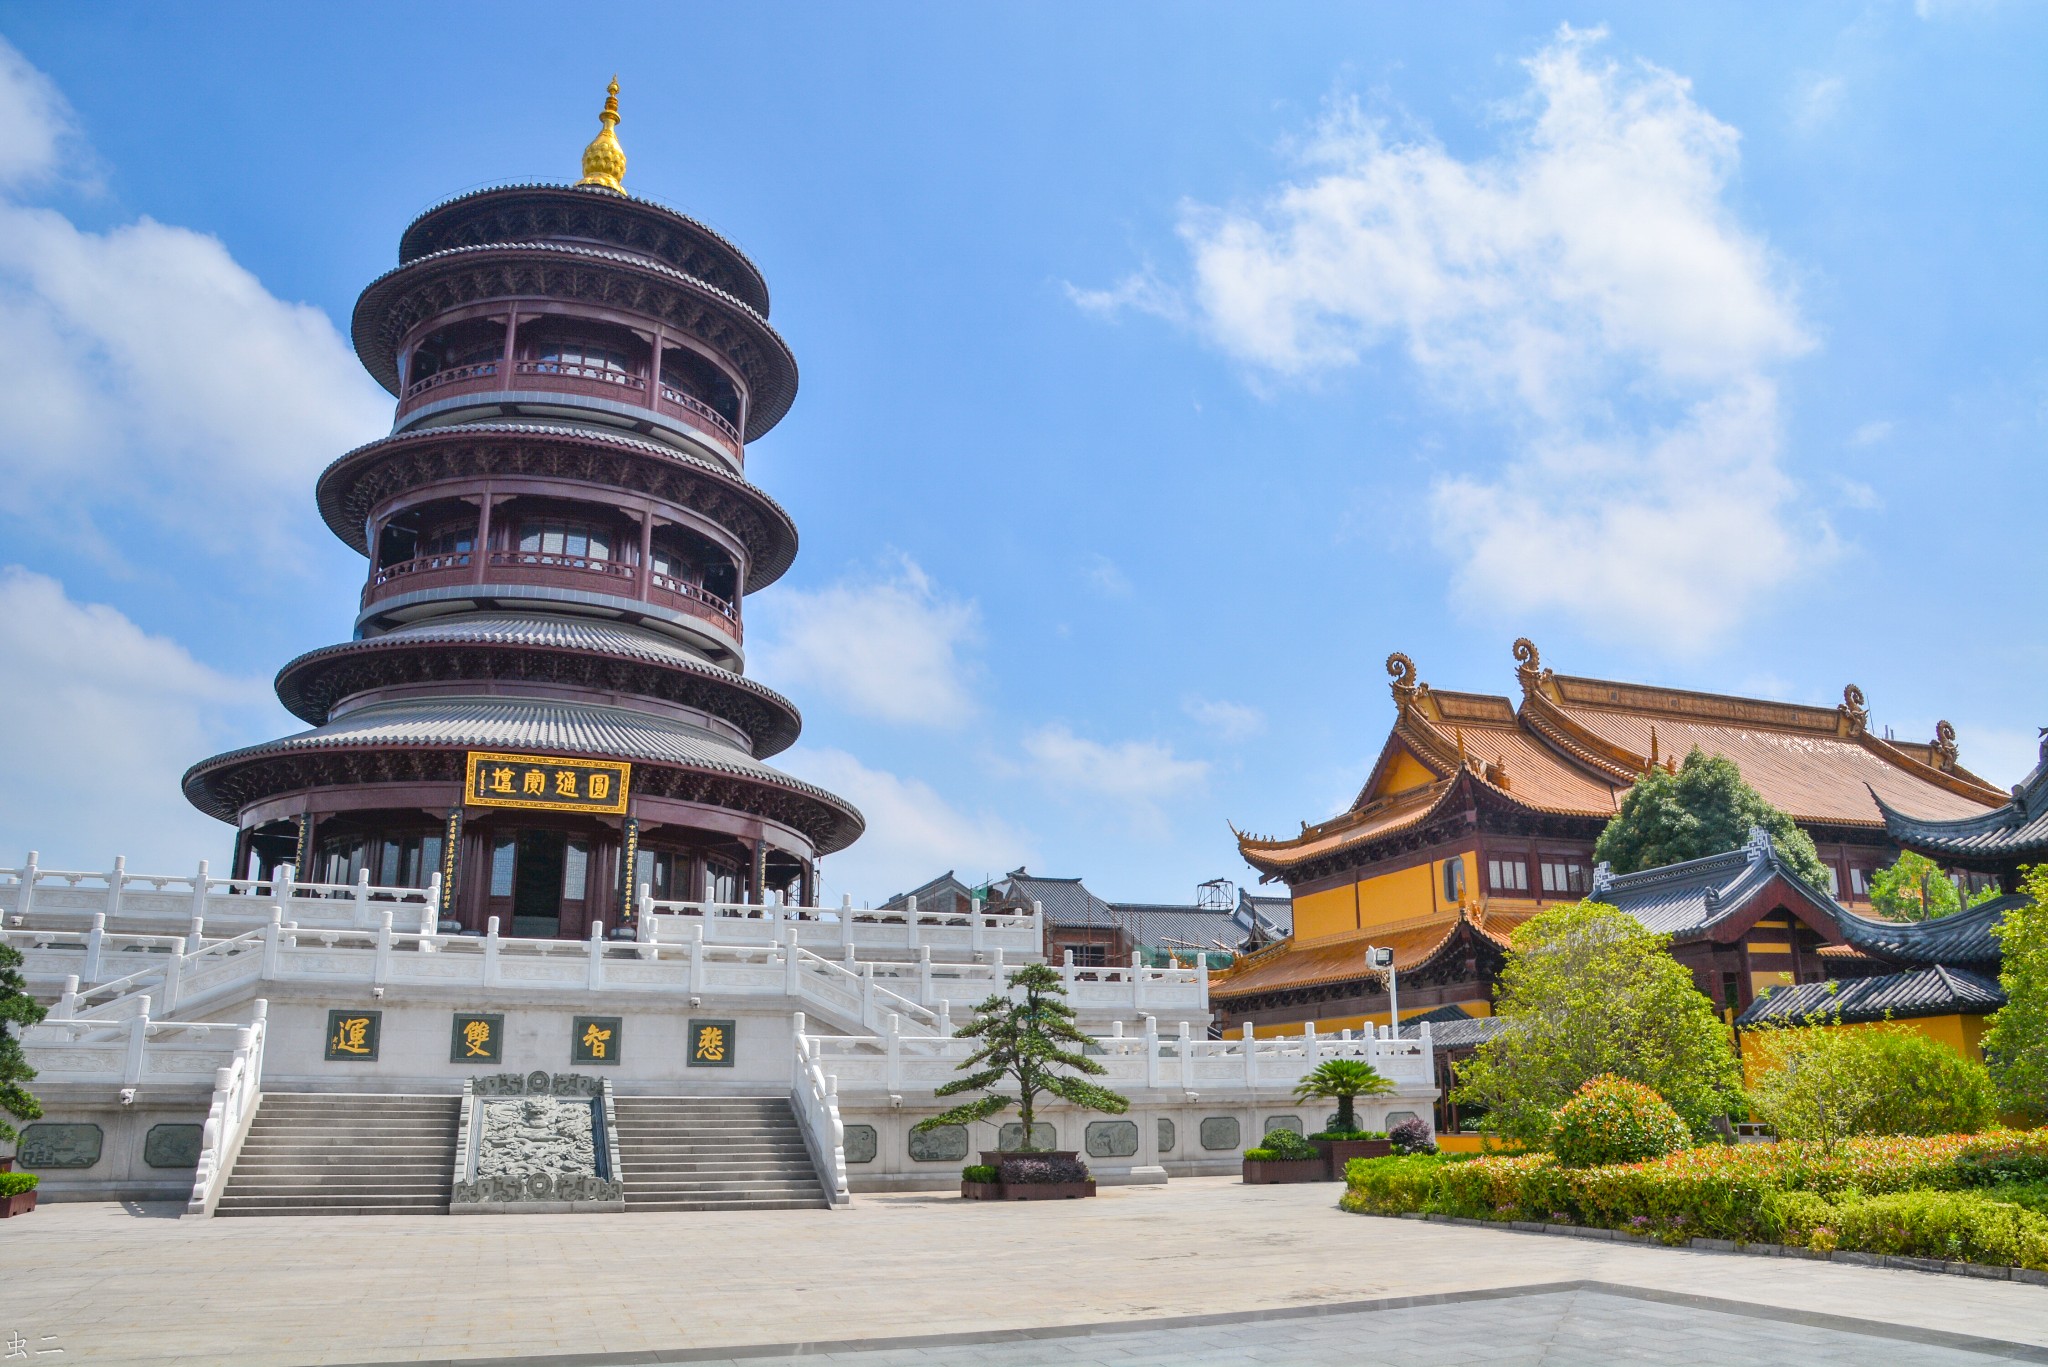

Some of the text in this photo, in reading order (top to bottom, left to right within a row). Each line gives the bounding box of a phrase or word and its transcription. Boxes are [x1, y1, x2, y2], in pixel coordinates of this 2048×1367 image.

[337, 1018, 371, 1054] 運
[464, 1021, 490, 1056] 雙
[582, 1023, 611, 1058] 智
[696, 1026, 725, 1061] 悲
